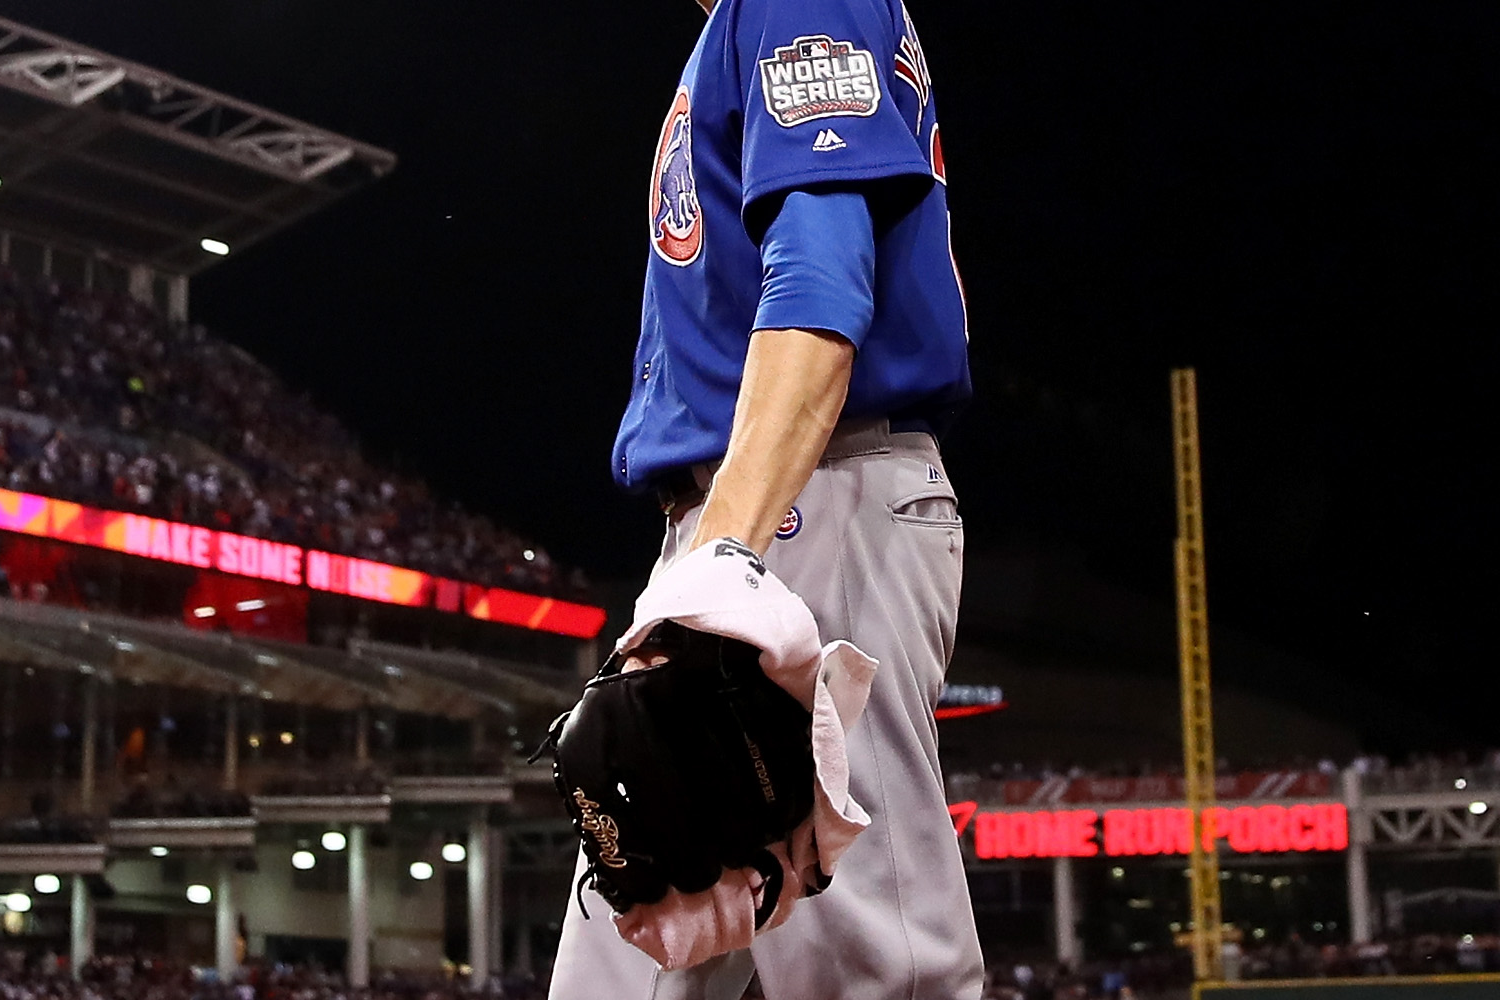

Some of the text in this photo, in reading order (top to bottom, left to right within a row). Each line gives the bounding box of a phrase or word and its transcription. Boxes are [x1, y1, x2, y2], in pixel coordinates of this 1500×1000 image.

[766, 54, 869, 85] WORLD
[771, 75, 874, 110] SERIES
[124, 512, 393, 603] MAKE SOME NOISE
[573, 786, 627, 868] Rawlings
[974, 803, 1349, 860] HOME RUN PORCH
